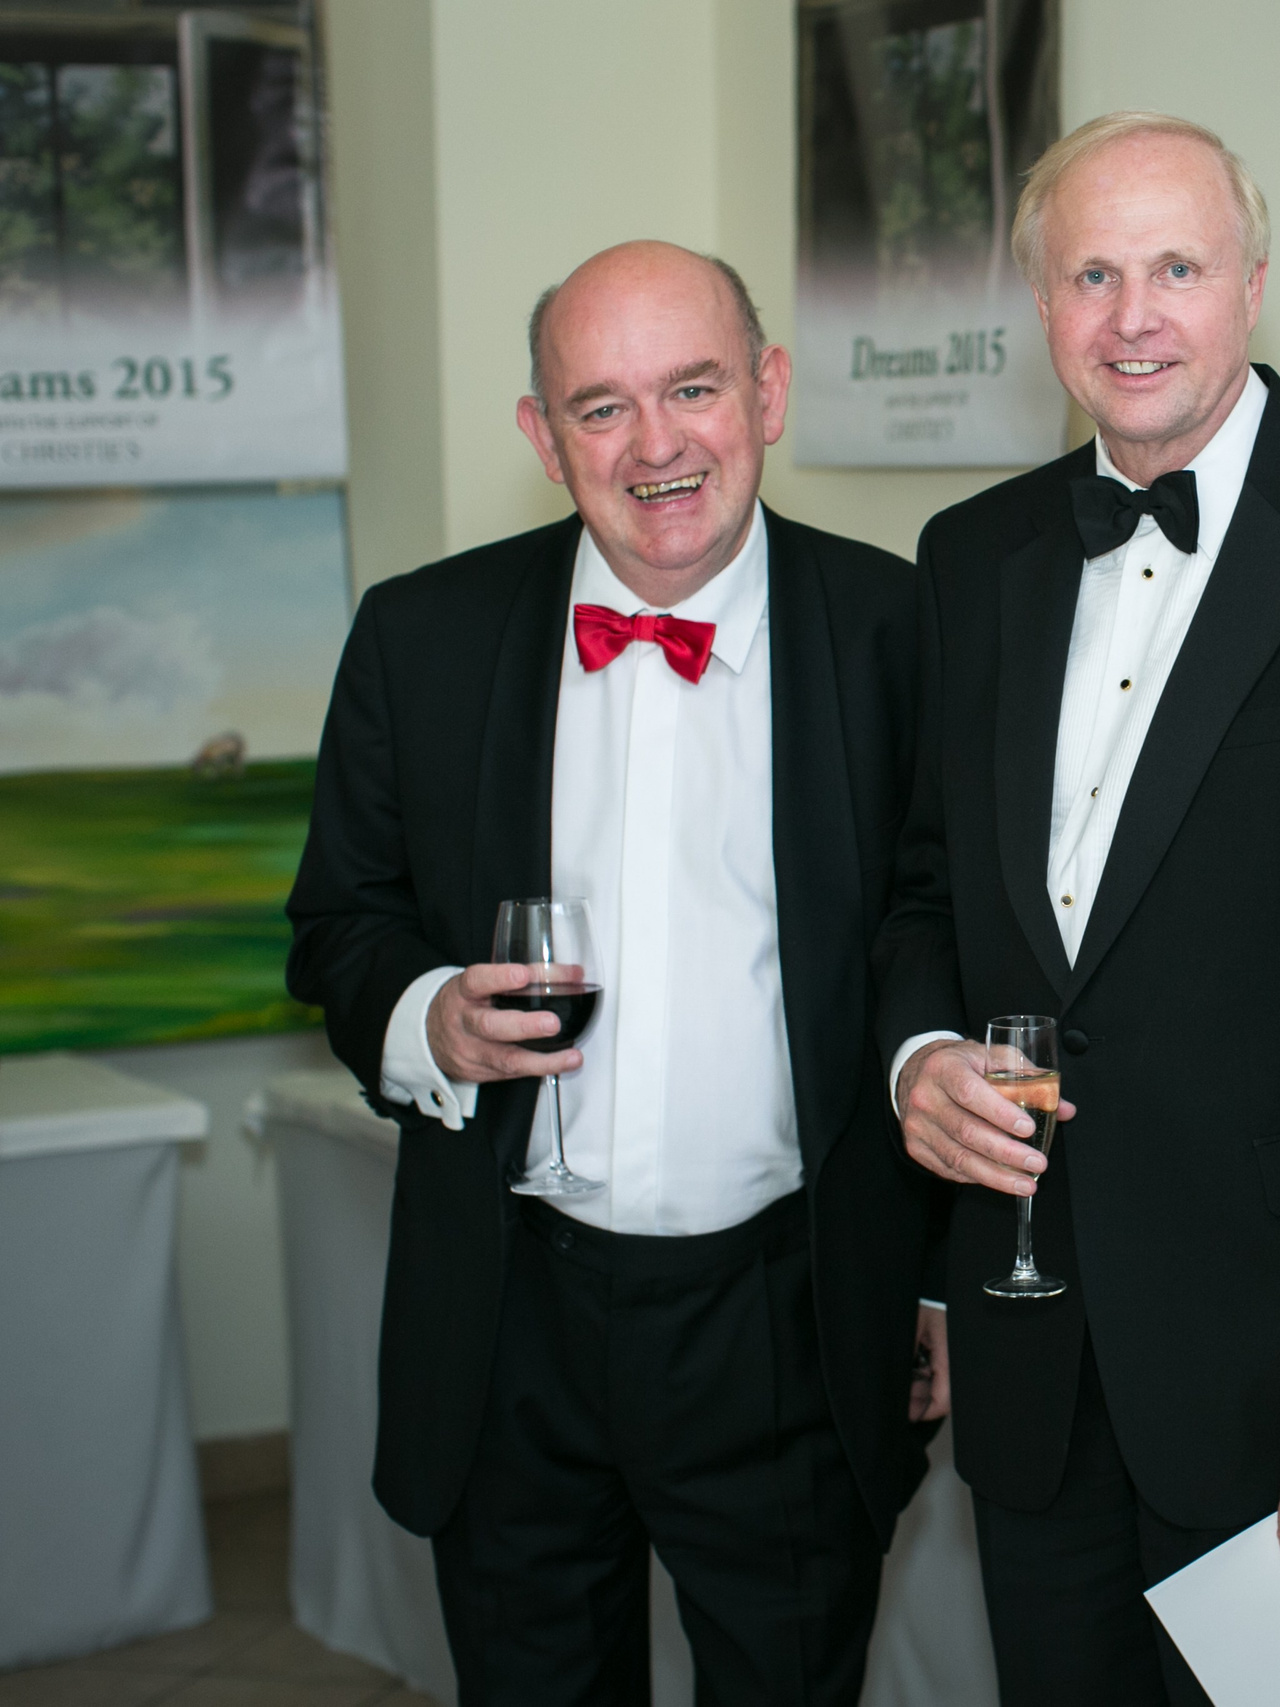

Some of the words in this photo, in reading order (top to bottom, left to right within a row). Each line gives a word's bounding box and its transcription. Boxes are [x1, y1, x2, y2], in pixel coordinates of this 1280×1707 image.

[111, 354, 235, 402] 2015
[851, 335, 938, 380] Dreams
[946, 327, 1007, 377] 2015
